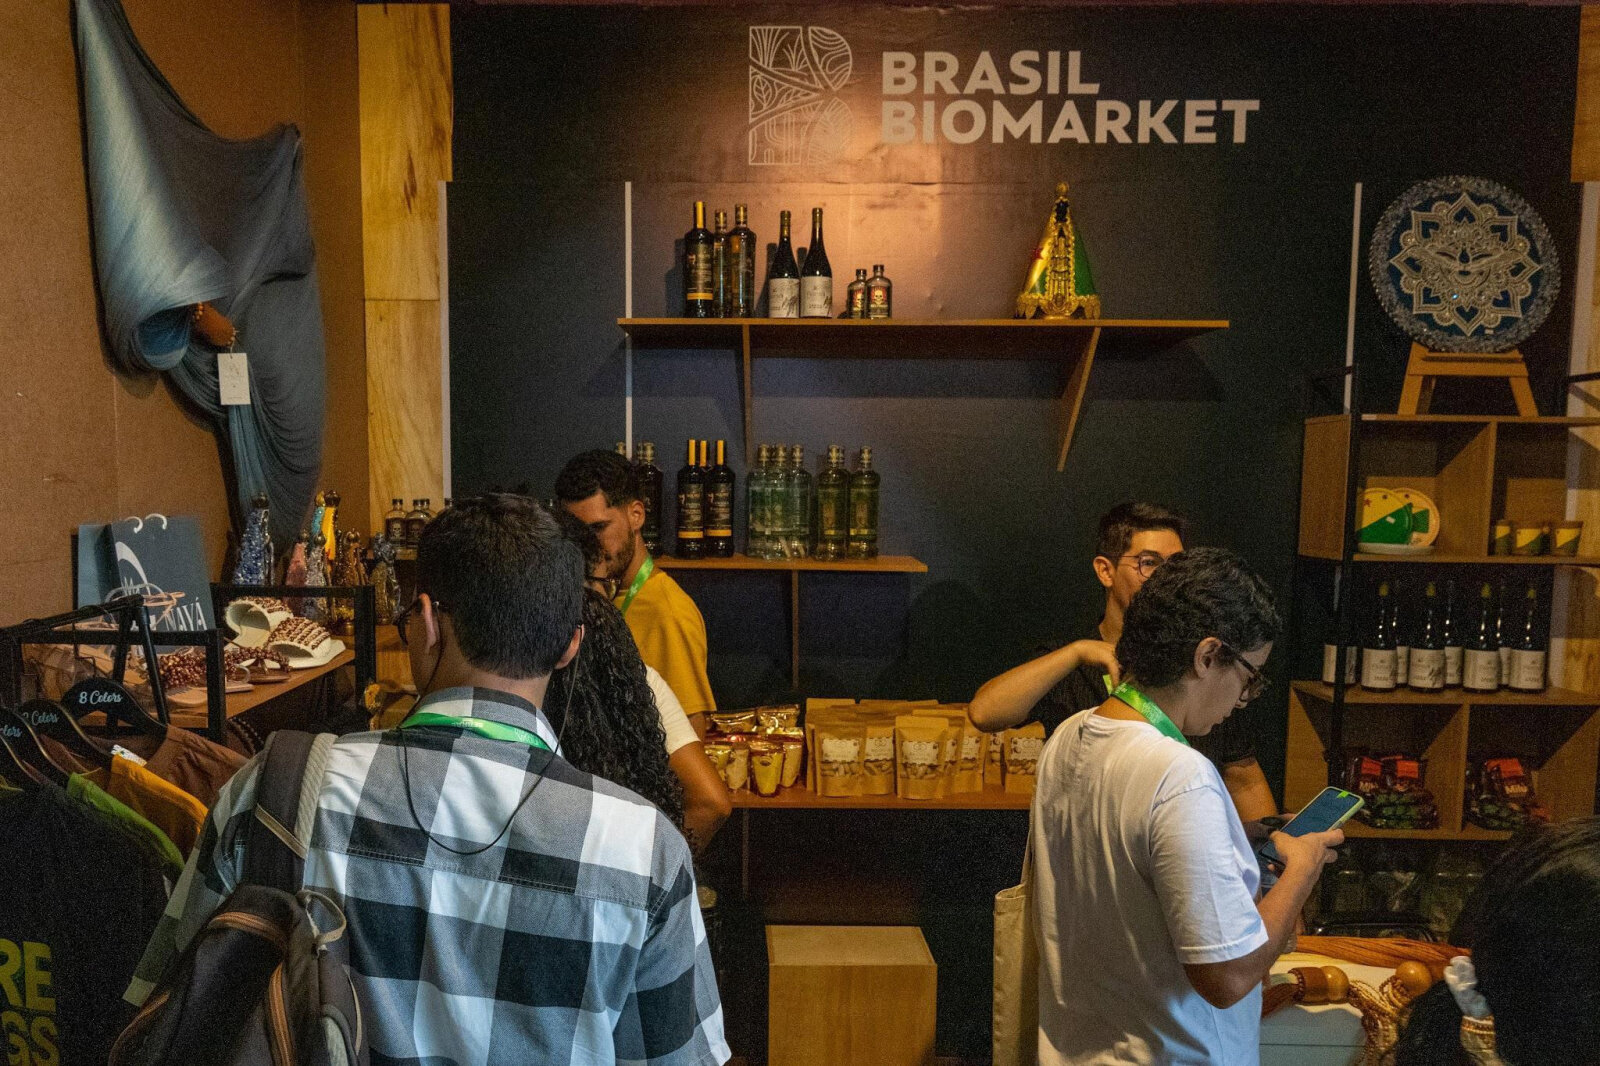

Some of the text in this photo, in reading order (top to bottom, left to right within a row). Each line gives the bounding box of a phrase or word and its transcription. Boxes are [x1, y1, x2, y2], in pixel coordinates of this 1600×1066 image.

[882, 50, 1100, 95] BRASIL
[882, 100, 1260, 144] BIOMARKET
[79, 690, 123, 705] 8 Colors
